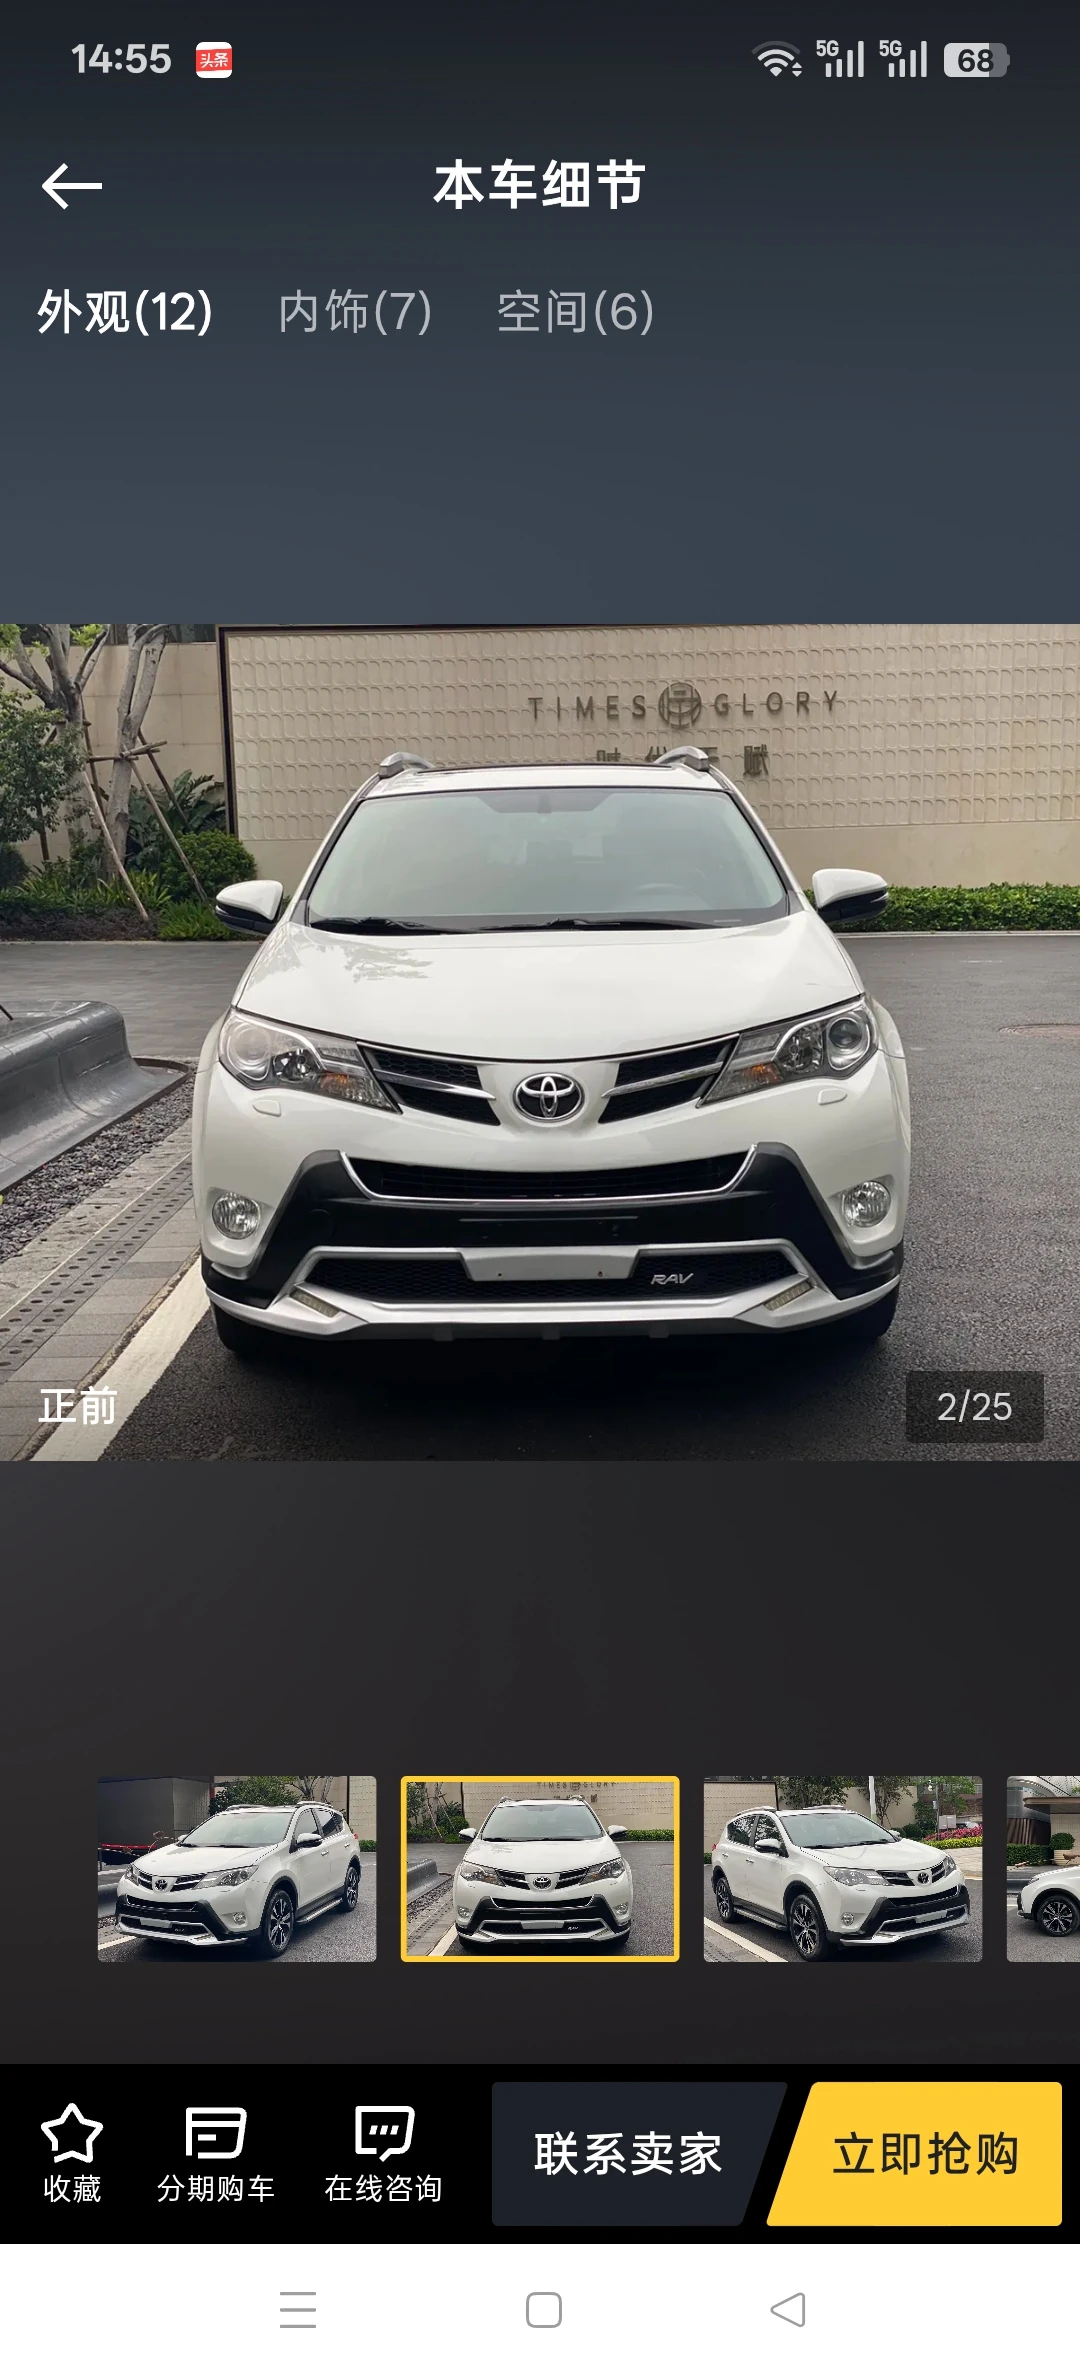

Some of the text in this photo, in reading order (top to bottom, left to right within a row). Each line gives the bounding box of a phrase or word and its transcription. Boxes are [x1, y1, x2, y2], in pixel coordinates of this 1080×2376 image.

[71, 43, 172, 74] 14:55
[200, 52, 229, 69] 头条
[816, 39, 840, 57] 5G
[879, 39, 903, 57] 5G
[957, 48, 994, 73] 68
[433, 158, 646, 210] 本车细节
[36, 288, 212, 337] 外观(12)
[280, 288, 431, 336] 内饰(7)
[497, 288, 654, 336] 空间(6)
[528, 690, 838, 720] TIMES GLORY
[651, 1272, 694, 1285] RAV
[534, 2130, 723, 2177] 联系卖家
[833, 2131, 1020, 2177] 立即抢购
[43, 2174, 102, 2204] 收藏
[157, 2174, 275, 2204] 分期购车
[324, 2173, 442, 2204] 在线咨询
